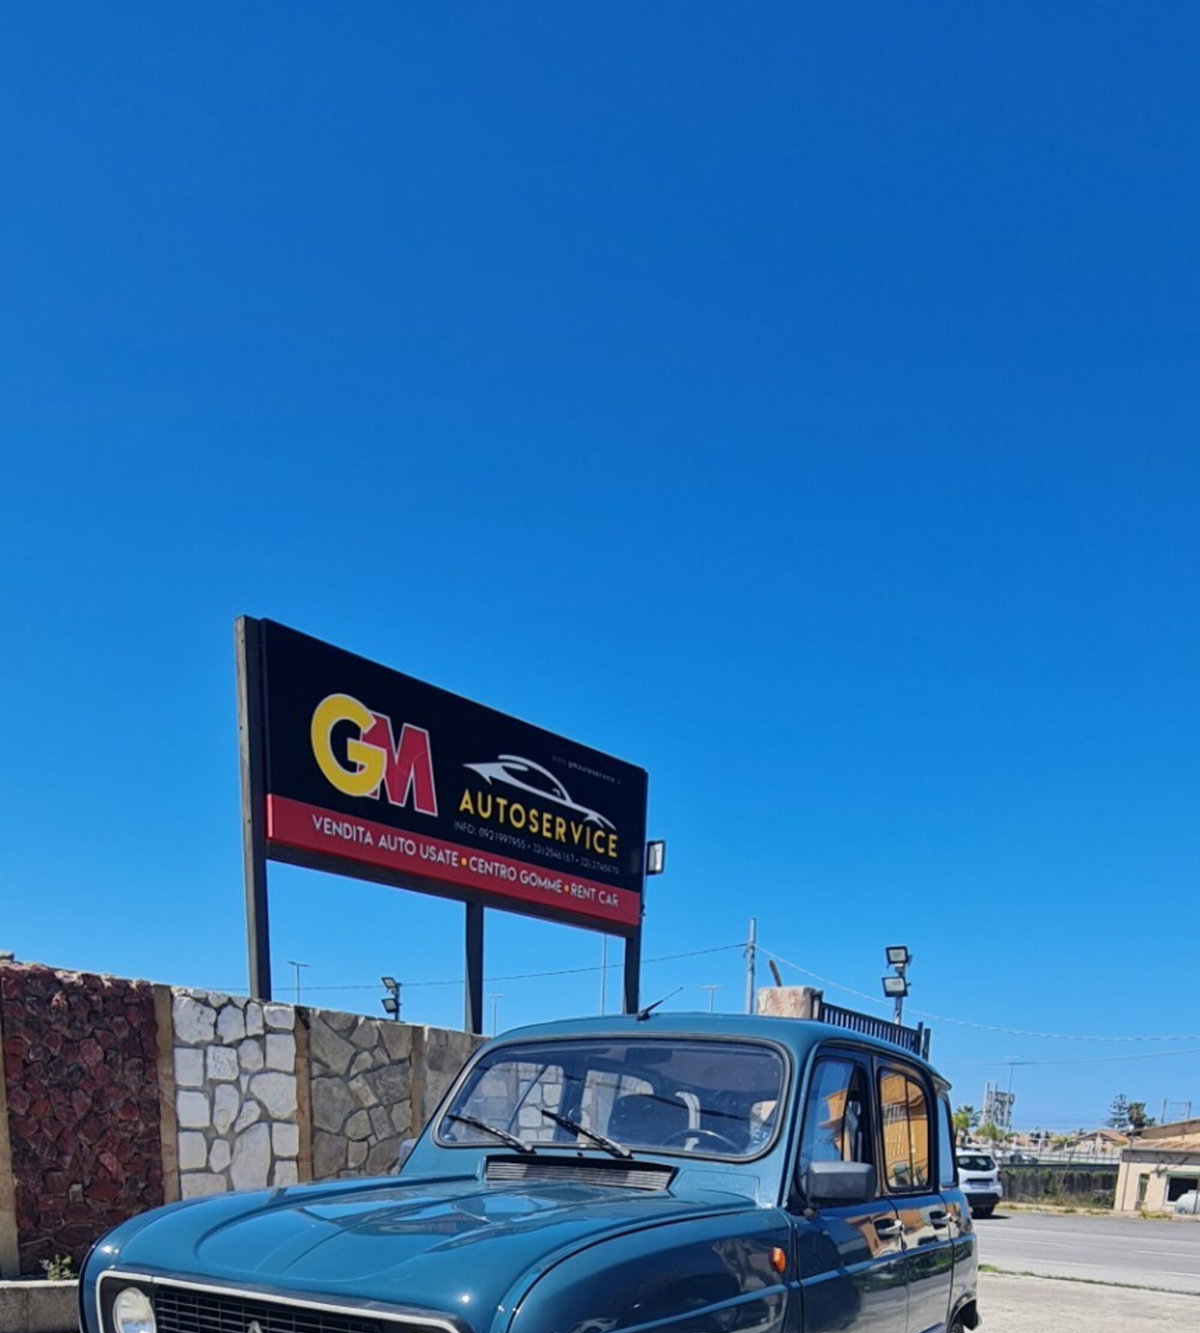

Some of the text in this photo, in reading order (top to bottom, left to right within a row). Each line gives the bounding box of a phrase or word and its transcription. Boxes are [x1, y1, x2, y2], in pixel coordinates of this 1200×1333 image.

[310, 693, 438, 817] GM
[312, 814, 619, 907] VENDITA AUTO USATE CENTRO GOMME RENT CAR
[454, 821, 477, 836] INFO:
[459, 787, 619, 858] AUTOSERVICE
